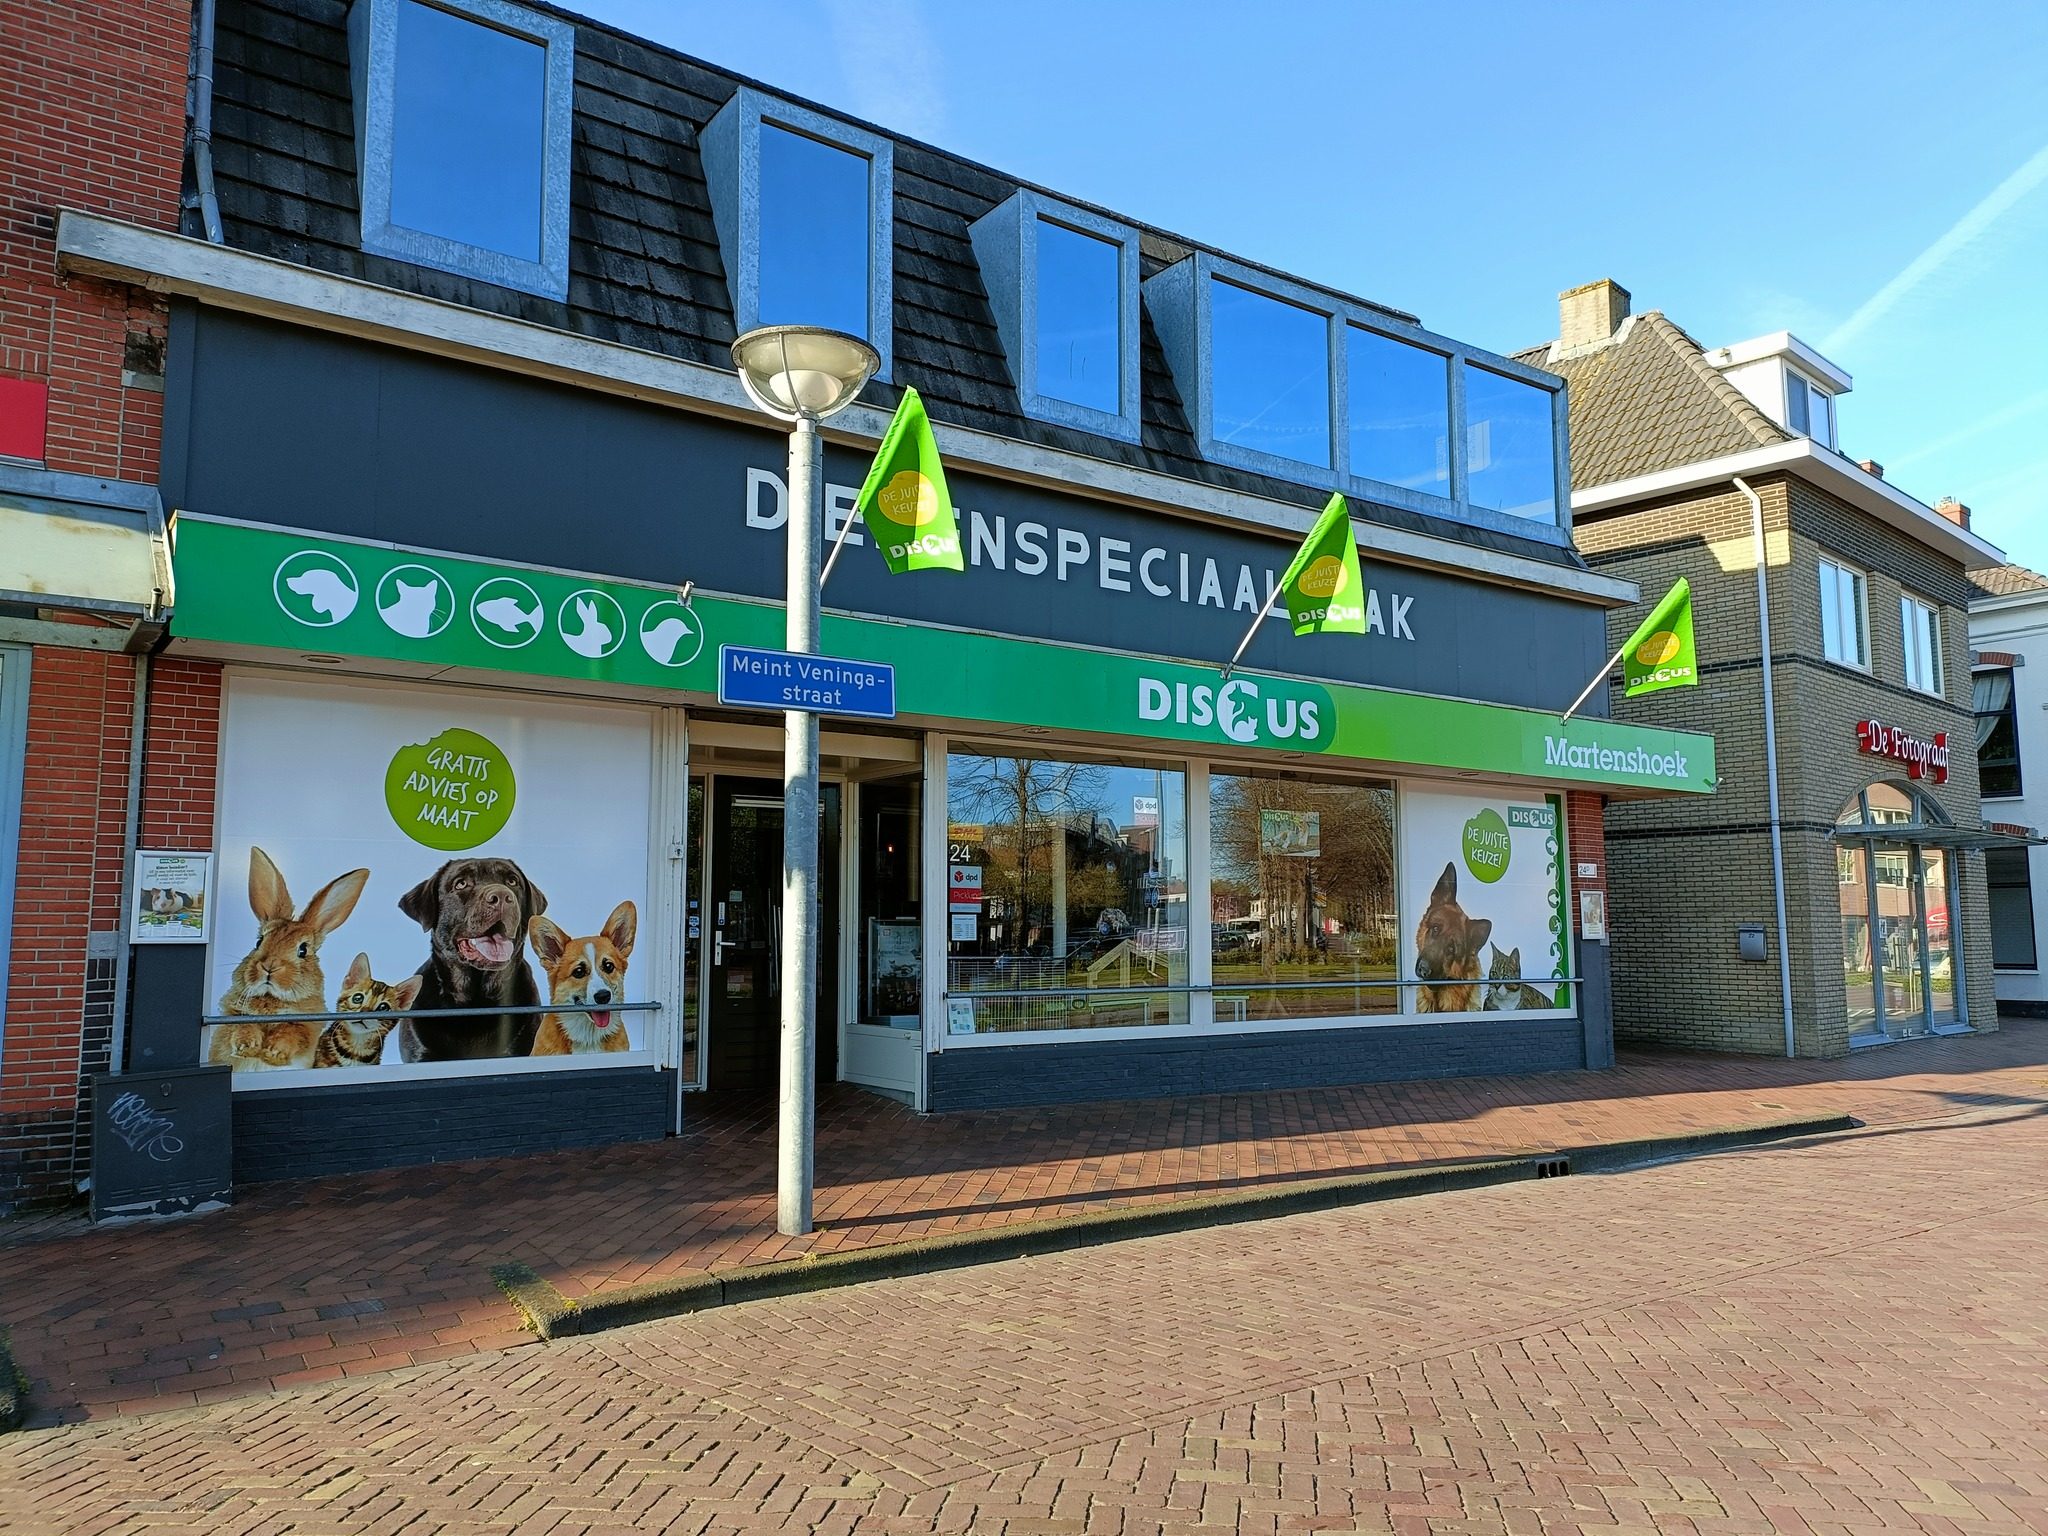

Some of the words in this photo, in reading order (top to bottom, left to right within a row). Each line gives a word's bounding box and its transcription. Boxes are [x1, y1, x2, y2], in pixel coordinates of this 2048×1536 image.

[733, 655, 791, 678] Meint
[798, 662, 886, 690] Veninga-
[1630, 667, 1692, 686] DISCUS
[782, 685, 842, 705] straat
[1138, 677, 1320, 742] DISCUS
[426, 747, 491, 782] GRATIS
[1544, 736, 1689, 778] Martenshoek
[1868, 719, 1889, 754] De
[1892, 726, 1950, 784] Fotograaf
[402, 770, 470, 804] ADVIES
[475, 789, 498, 810] OP
[416, 803, 479, 831] MAAT
[1512, 809, 1554, 827] DISCUS
[1468, 826, 1479, 842] DE
[1480, 829, 1508, 850] JUISTE
[950, 844, 971, 862] 24
[1471, 847, 1503, 868] KEUZE!
[965, 873, 978, 883] dpd
